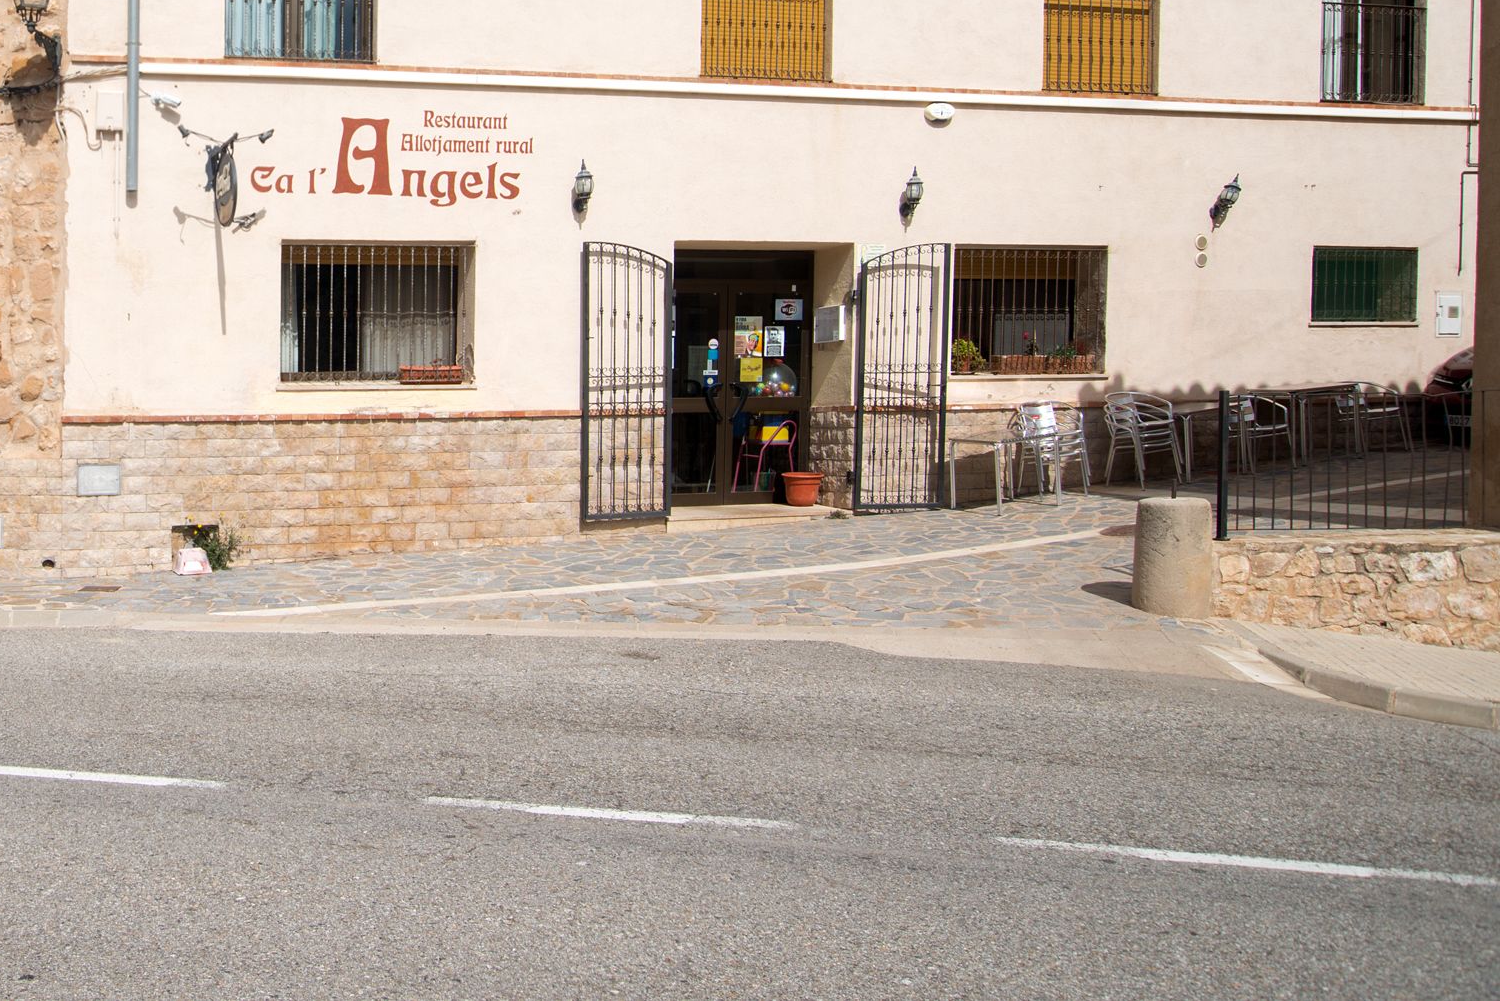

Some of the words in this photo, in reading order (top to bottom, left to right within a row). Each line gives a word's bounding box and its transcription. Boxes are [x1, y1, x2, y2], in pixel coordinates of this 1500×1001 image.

[423, 109, 508, 131] Restaurant
[400, 133, 490, 157] Allotjament
[496, 137, 534, 155] rural
[250, 165, 294, 195] Ca
